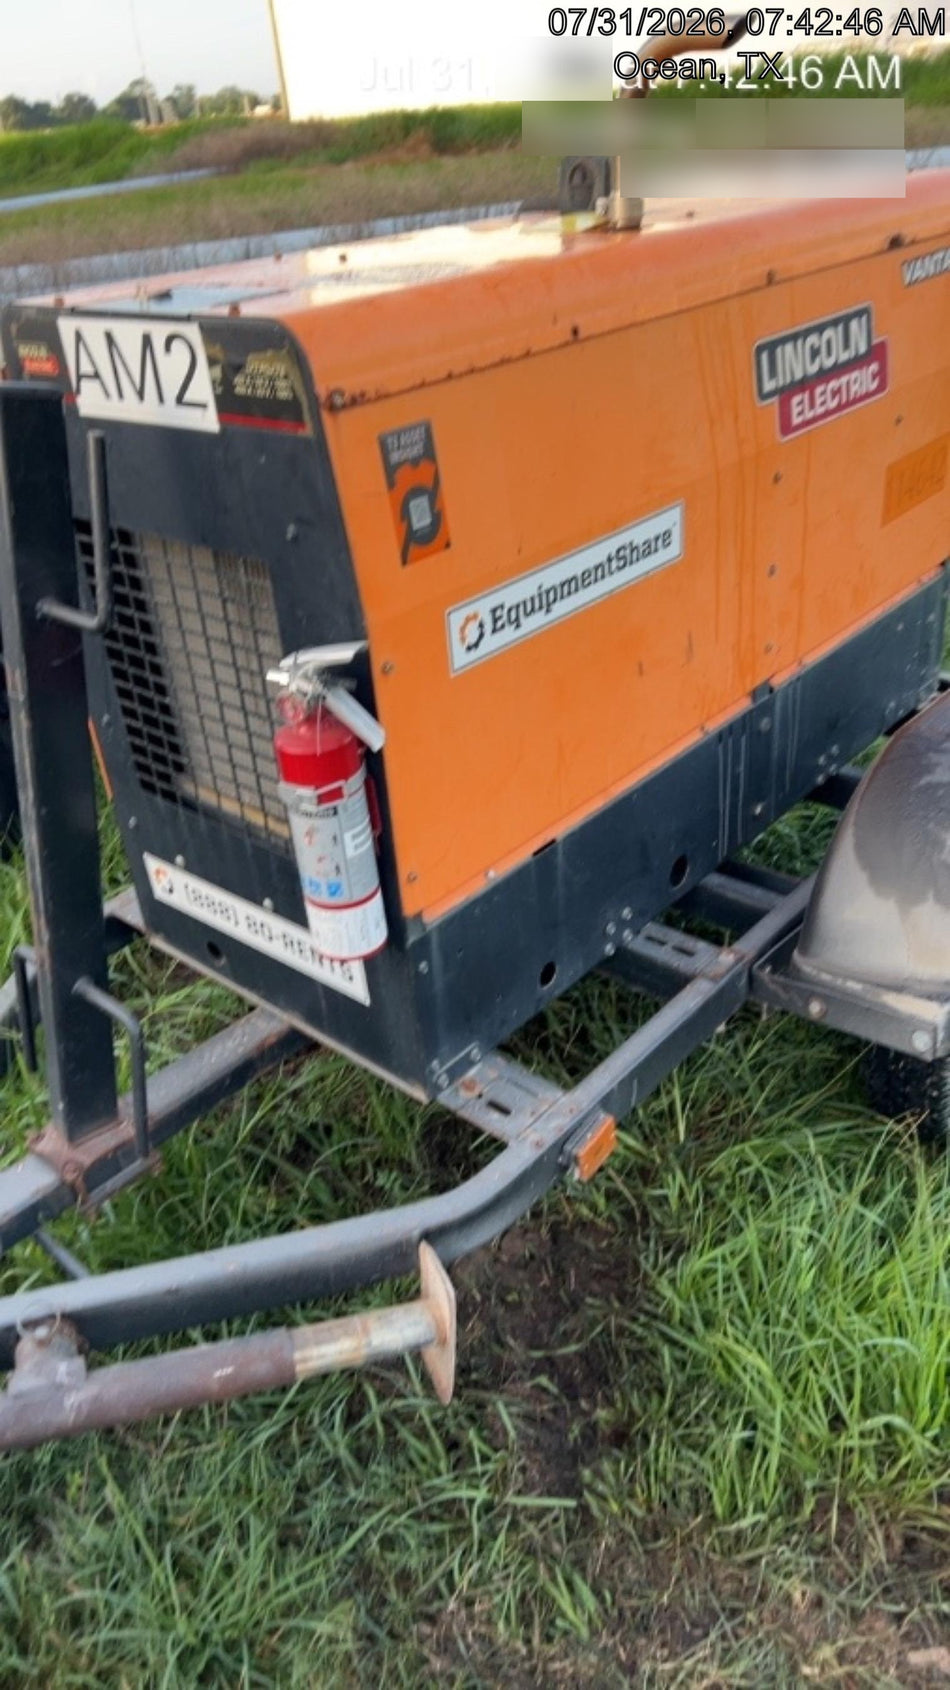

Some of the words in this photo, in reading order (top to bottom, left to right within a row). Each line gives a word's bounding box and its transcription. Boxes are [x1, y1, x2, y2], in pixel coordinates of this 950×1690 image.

[73, 329, 208, 408] AM2
[761, 314, 869, 394] LINCOLN
[790, 363, 880, 427] ELECTRIC
[489, 528, 674, 635] EquipmentShare
